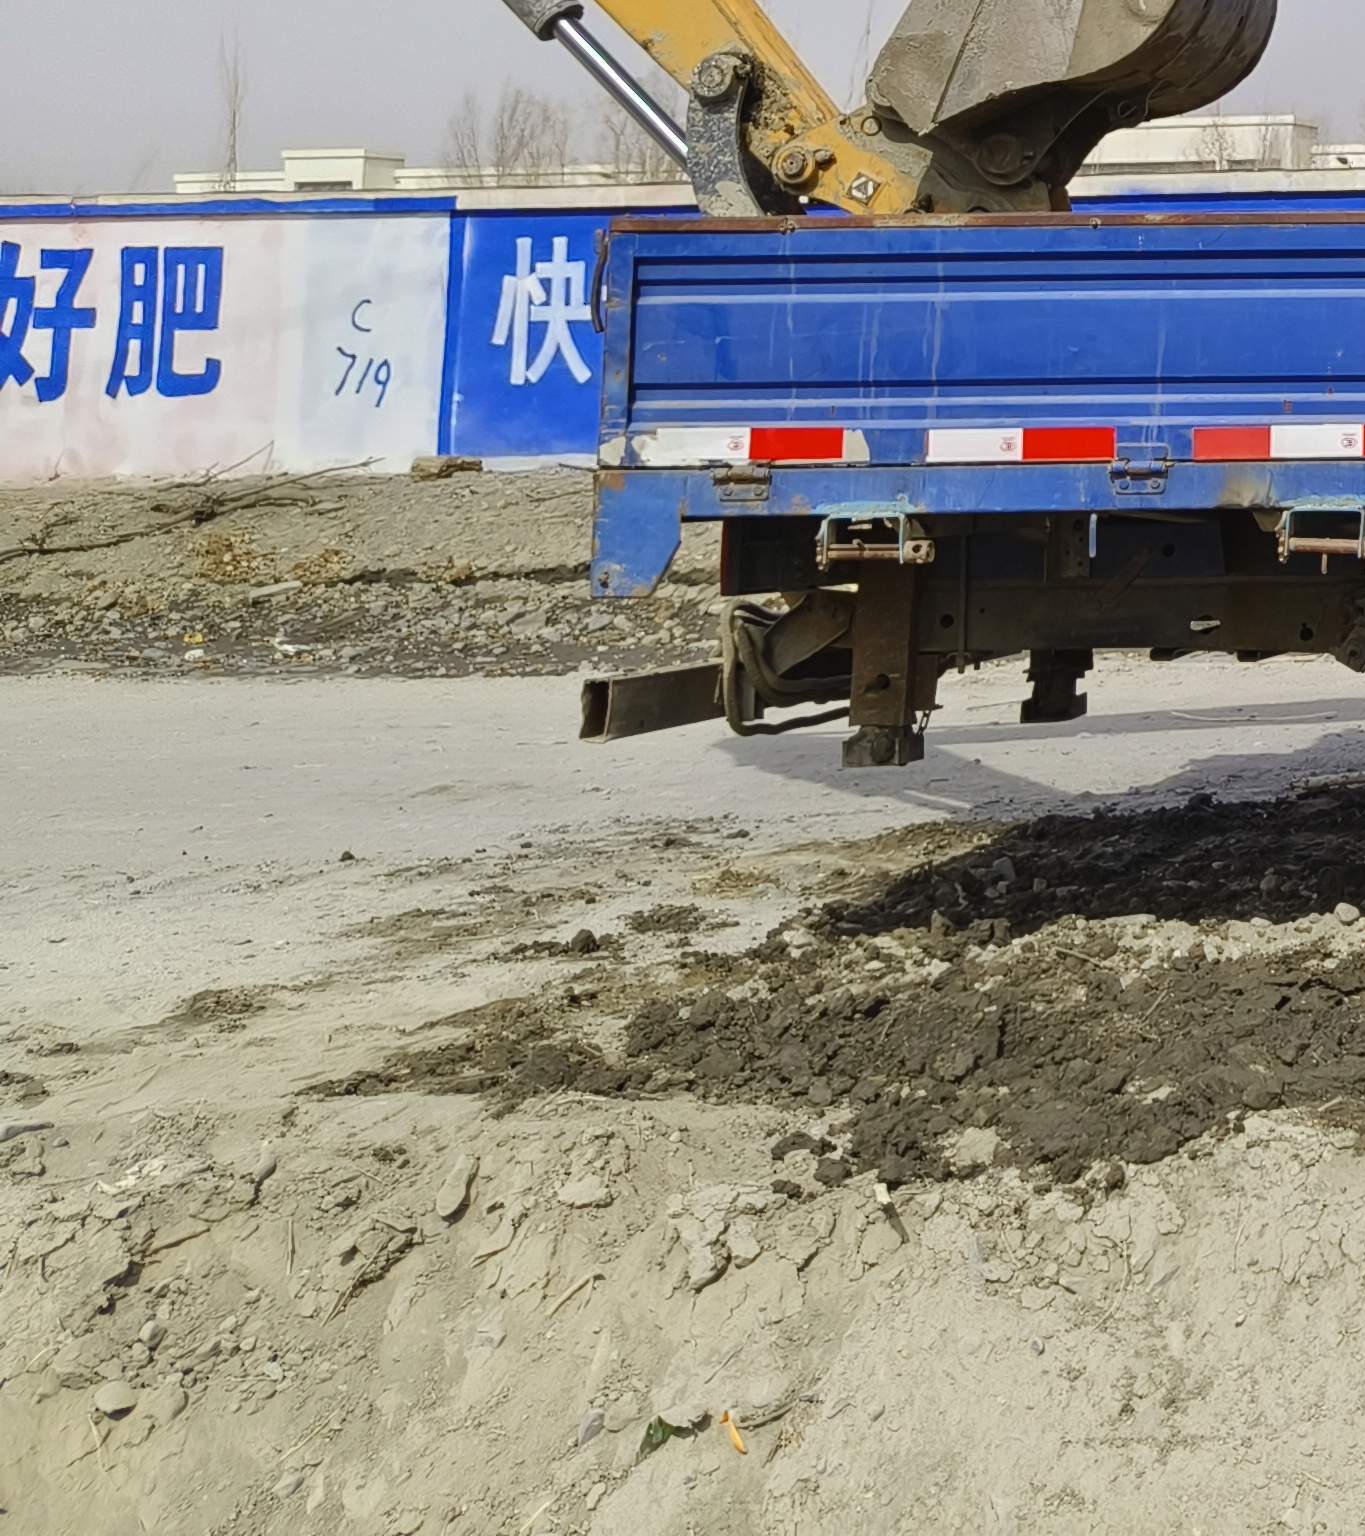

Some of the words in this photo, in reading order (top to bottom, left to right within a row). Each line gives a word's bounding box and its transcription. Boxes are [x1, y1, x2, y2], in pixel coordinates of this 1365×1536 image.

[0, 240, 224, 402] 好肥
[335, 346, 393, 408] 719
[491, 236, 594, 385] 快
